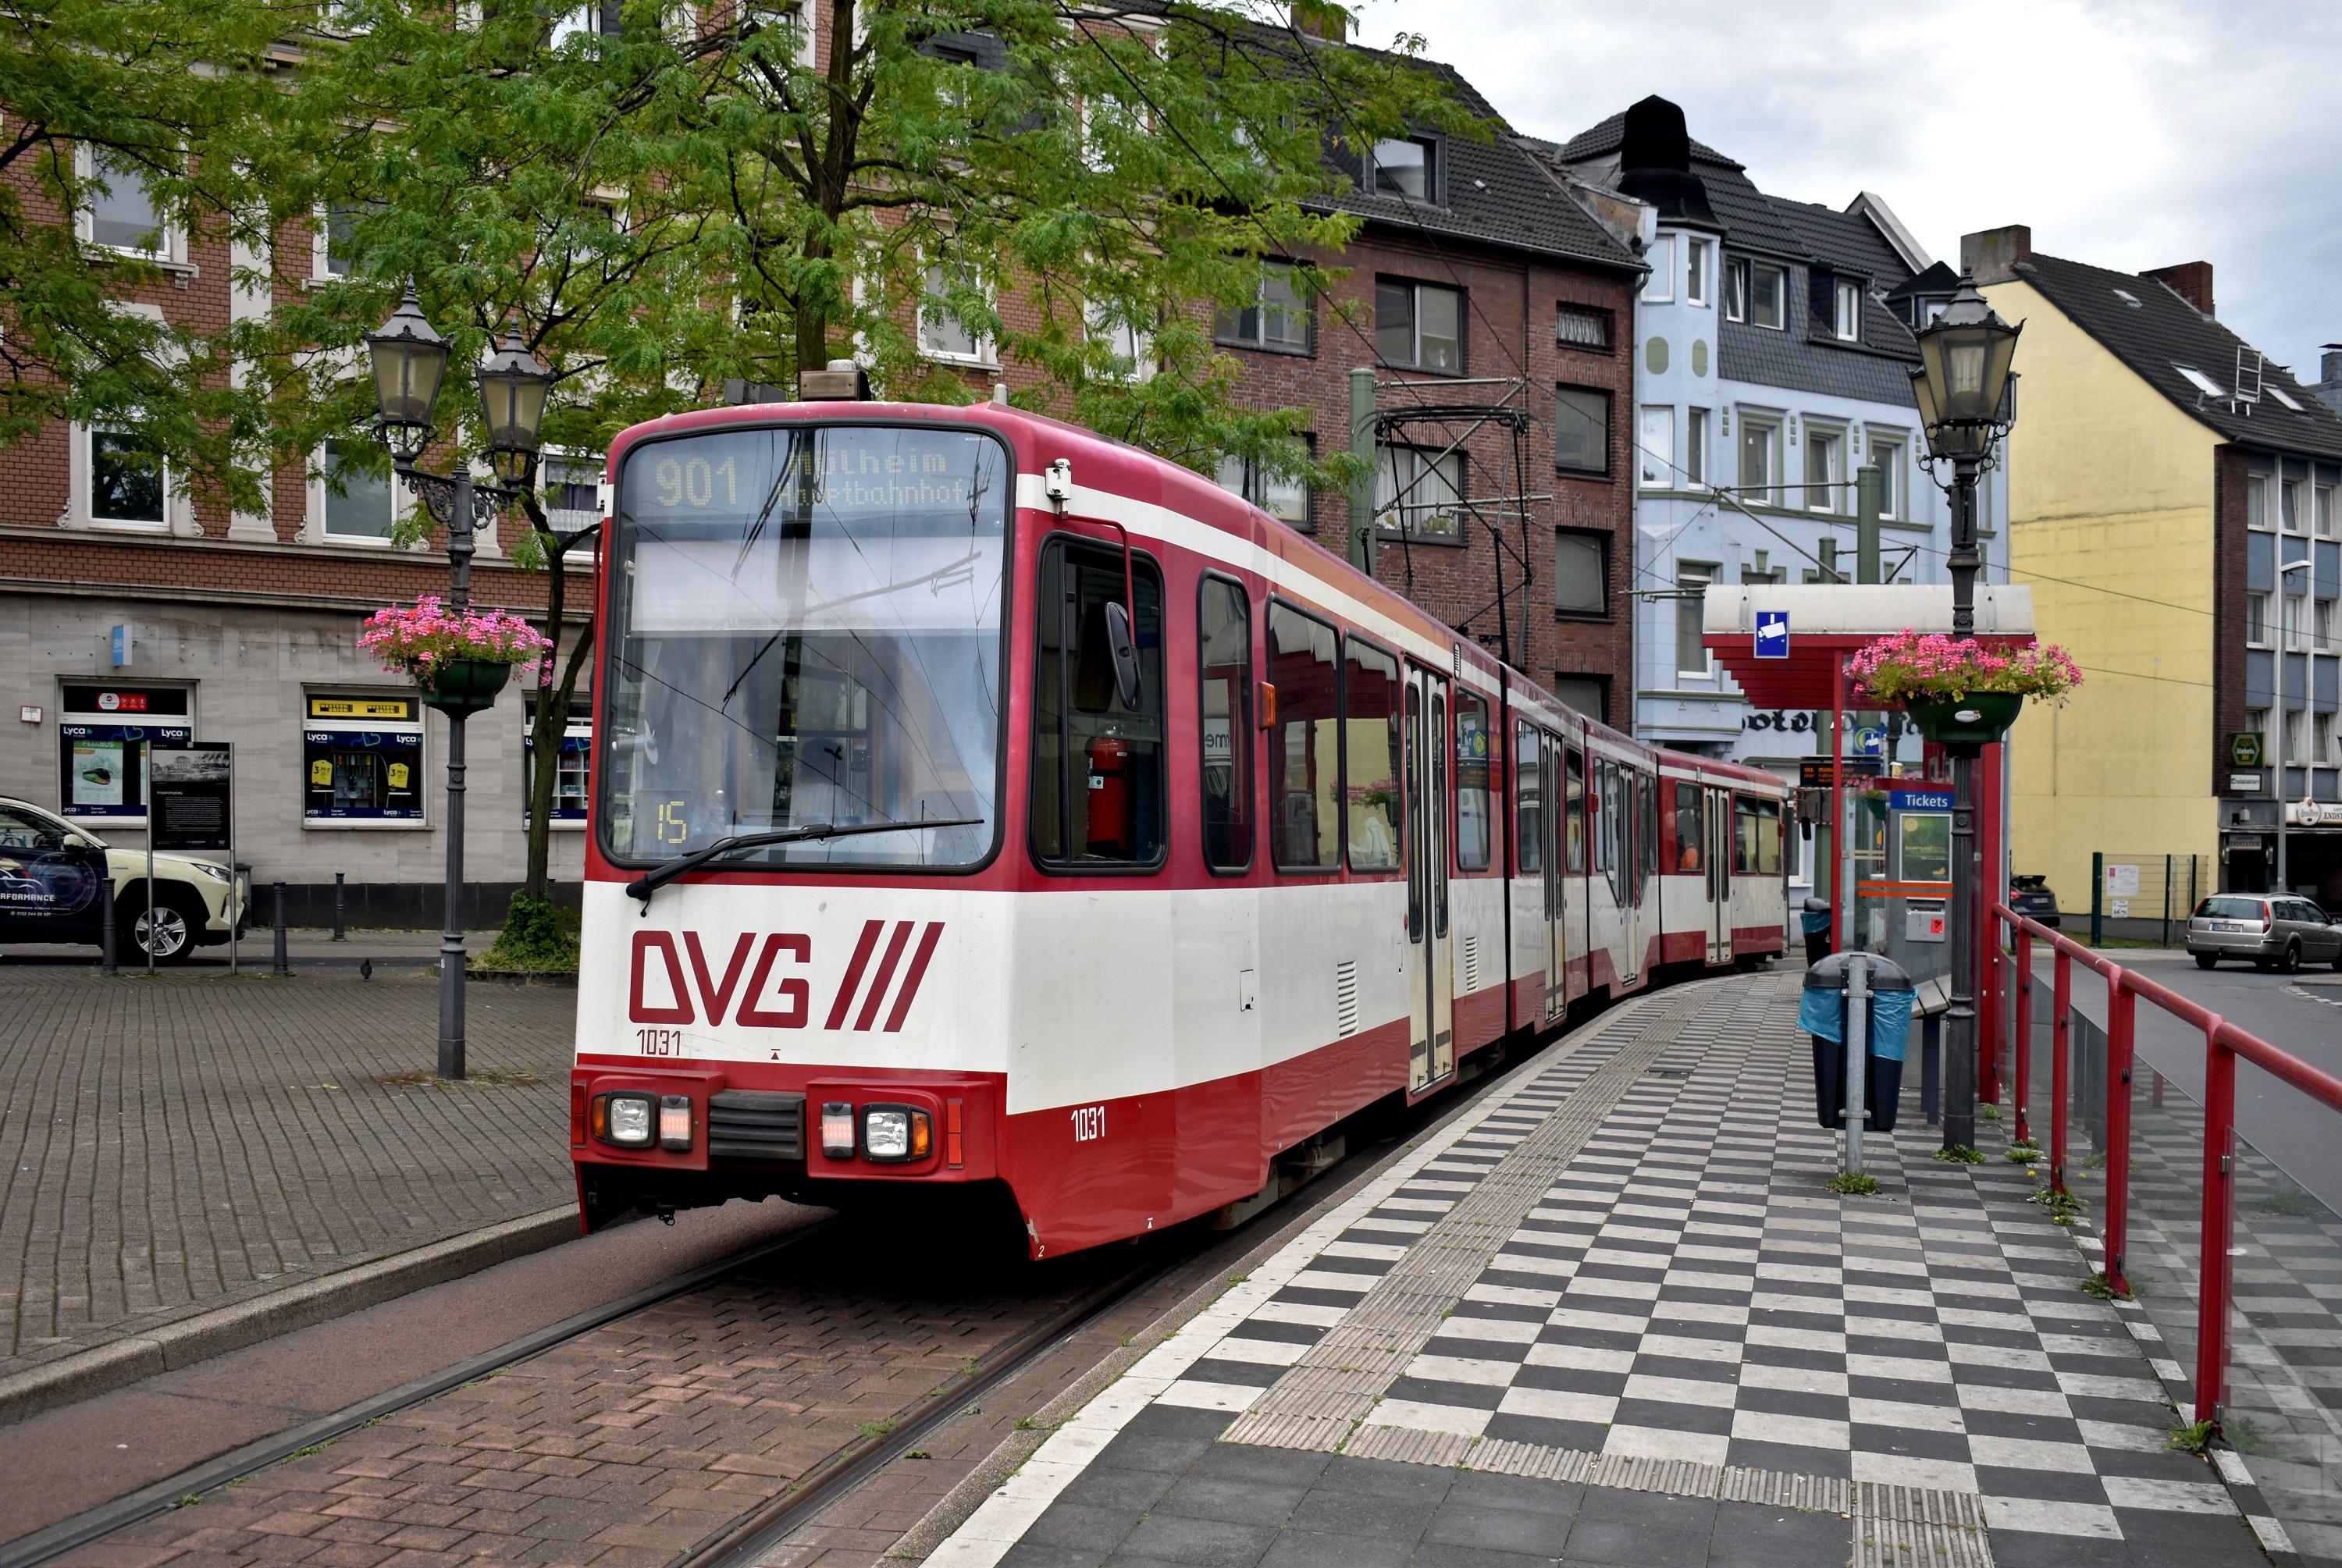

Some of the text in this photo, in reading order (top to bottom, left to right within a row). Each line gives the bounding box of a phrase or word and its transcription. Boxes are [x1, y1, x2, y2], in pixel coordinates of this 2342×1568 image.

[657, 457, 737, 507] 901
[63, 726, 86, 735] Lyca
[161, 728, 183, 738] Lyca
[307, 733, 328, 741] Lyca
[397, 734, 417, 744] Lyca
[1905, 795, 1948, 807] Tickets
[657, 802, 687, 844] 15
[628, 930, 812, 1029] DVG
[636, 1029, 682, 1056] 1031
[1070, 1105, 1105, 1142] 1031
[1038, 1245, 1045, 1257] 2
